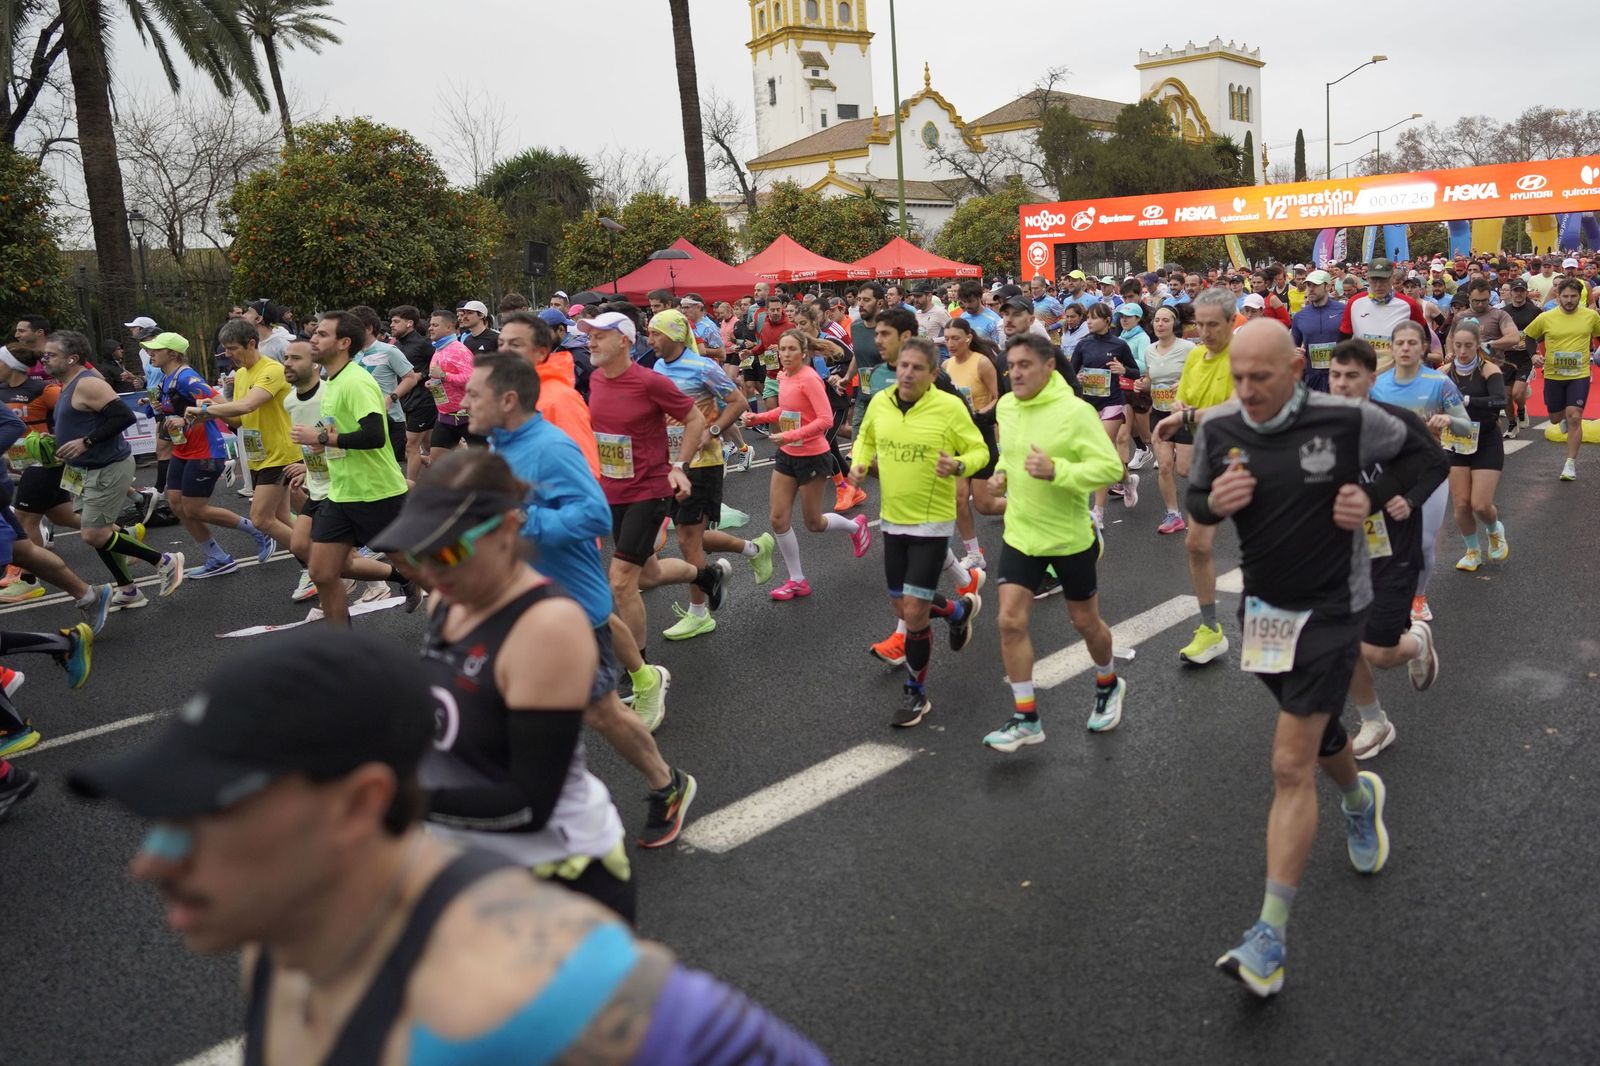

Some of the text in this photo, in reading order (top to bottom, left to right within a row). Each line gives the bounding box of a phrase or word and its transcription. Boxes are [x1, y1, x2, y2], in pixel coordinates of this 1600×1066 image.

[1283, 188, 1353, 206] maratón
[1370, 191, 1430, 207] 00:07:26
[1444, 182, 1500, 203] HOKA
[1510, 190, 1553, 200] HYUNDAI
[1174, 205, 1217, 222] HOKA
[1300, 200, 1354, 218] sevilla
[1138, 218, 1168, 227] HYUNDAI
